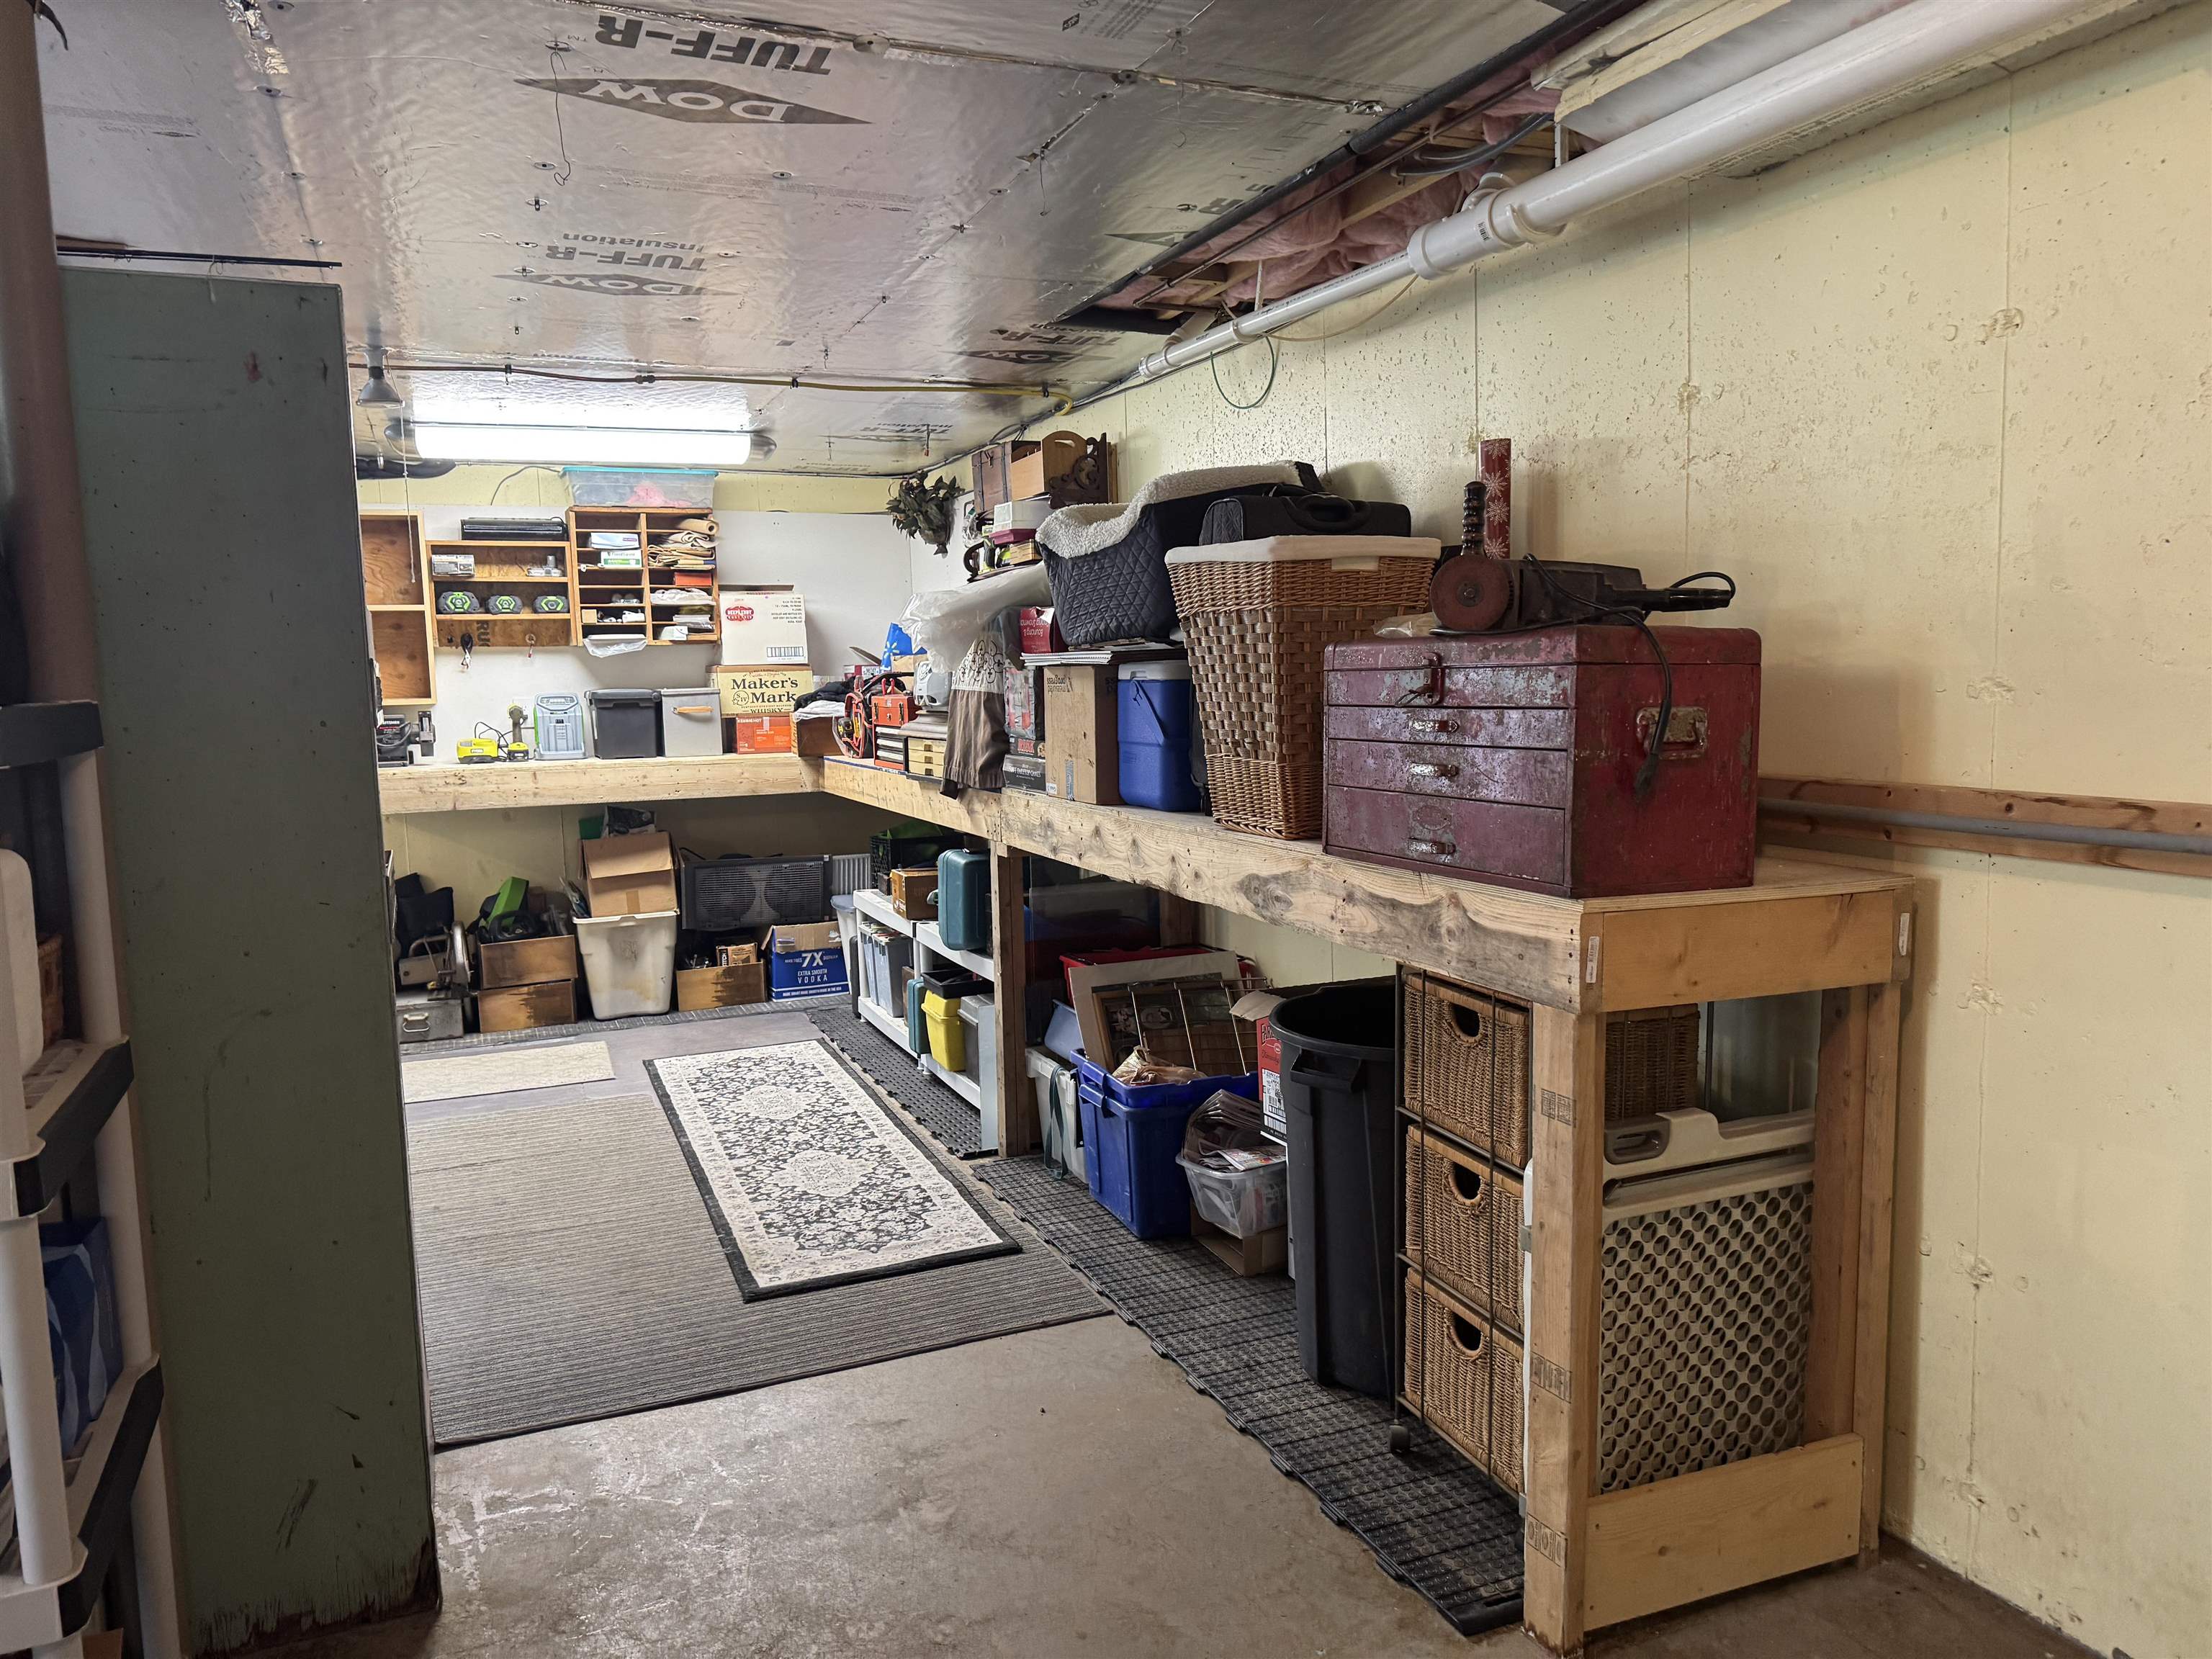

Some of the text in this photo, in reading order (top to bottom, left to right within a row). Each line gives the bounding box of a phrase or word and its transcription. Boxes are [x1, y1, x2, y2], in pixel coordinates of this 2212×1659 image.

[594, 14, 832, 75] TUFF-R
[578, 80, 796, 123] DOW
[562, 233, 703, 253] Insulation
[545, 245, 706, 271] TUFF-R
[538, 275, 685, 295] DOW
[731, 678, 799, 690] Maker's
[750, 691, 796, 703] Mark
[801, 950, 823, 967] 7X
[797, 974, 828, 984] VODKA
